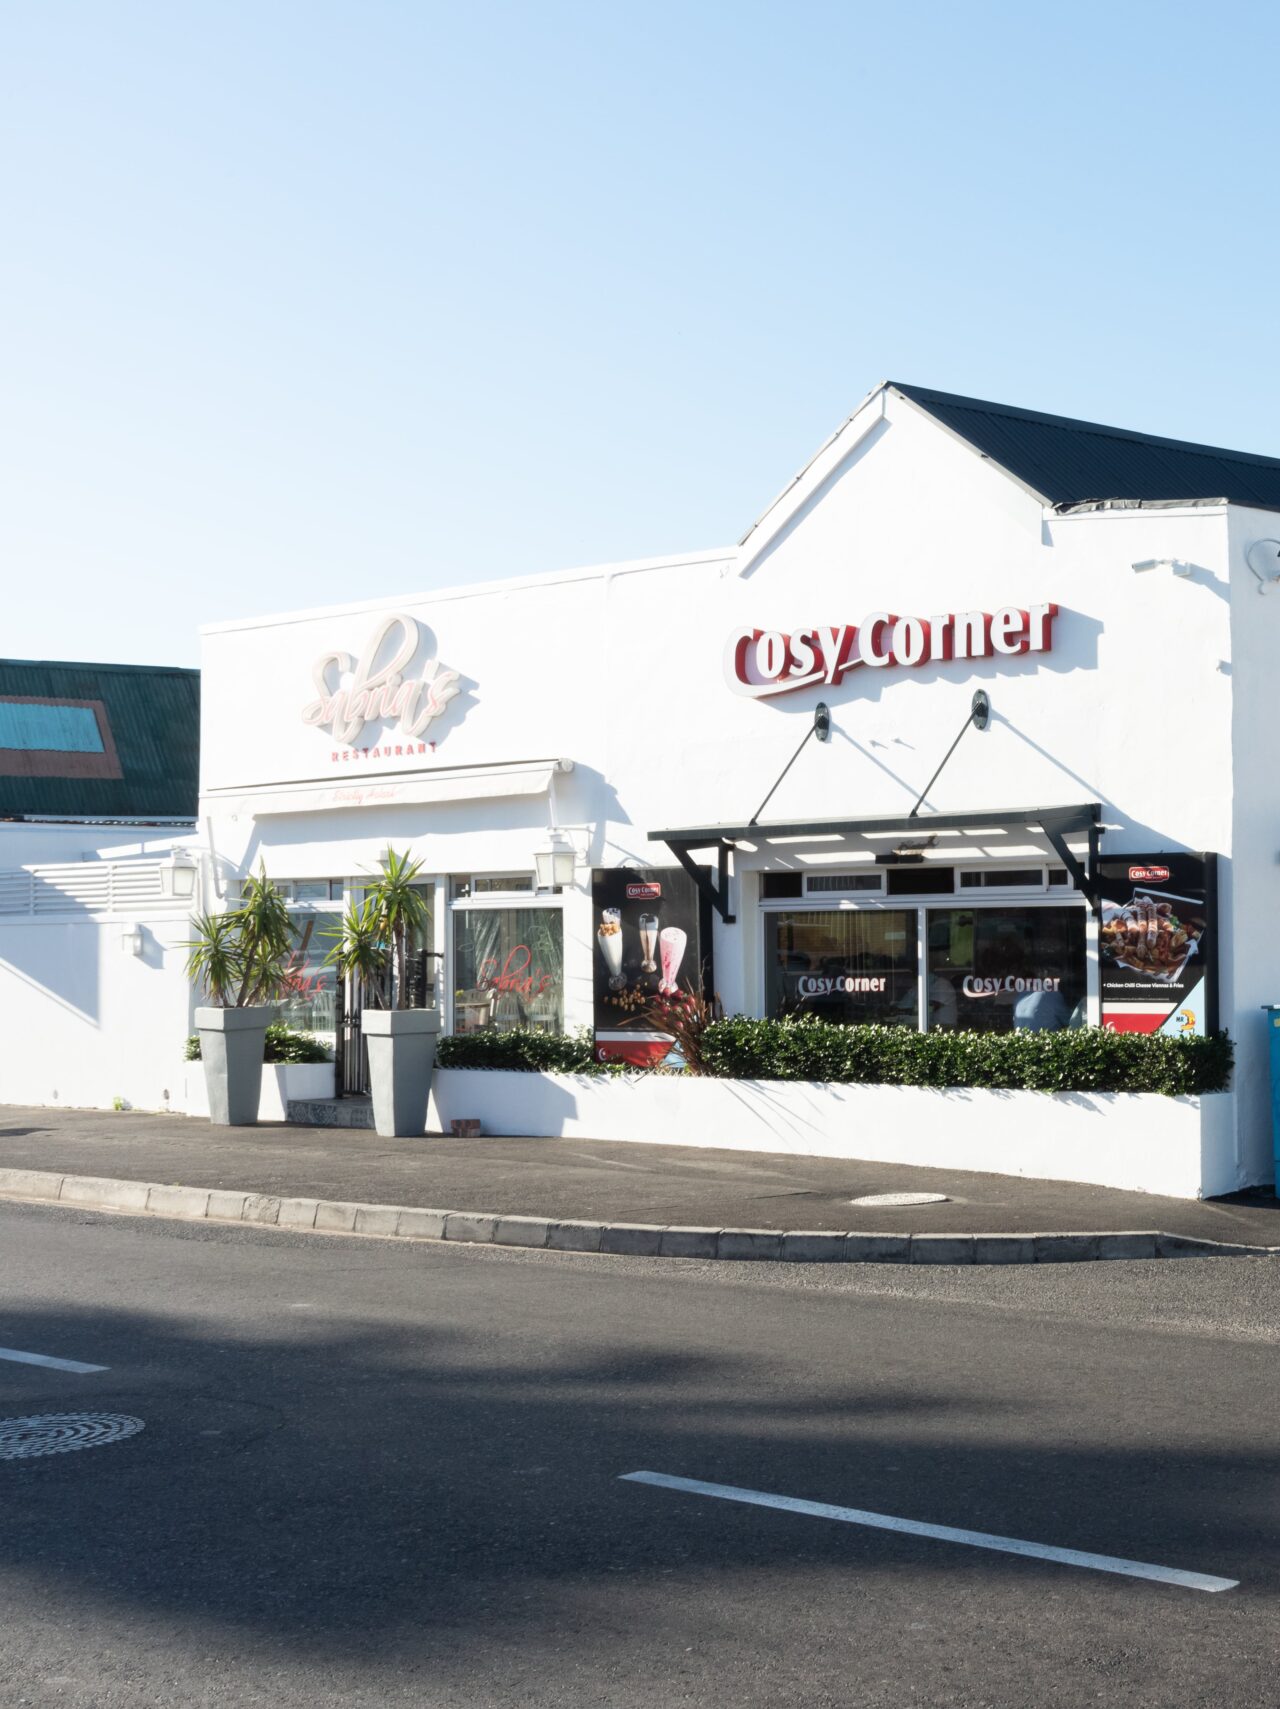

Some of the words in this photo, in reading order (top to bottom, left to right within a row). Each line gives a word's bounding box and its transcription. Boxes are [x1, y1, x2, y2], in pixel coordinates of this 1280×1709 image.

[723, 625, 858, 698] Cosy
[858, 602, 1058, 667] Corner
[331, 741, 437, 763] RESTAURANT
[798, 975, 836, 998] Cosy
[836, 975, 886, 992] Corner
[962, 975, 1003, 998] Cosy
[1005, 975, 1061, 992] Corner
